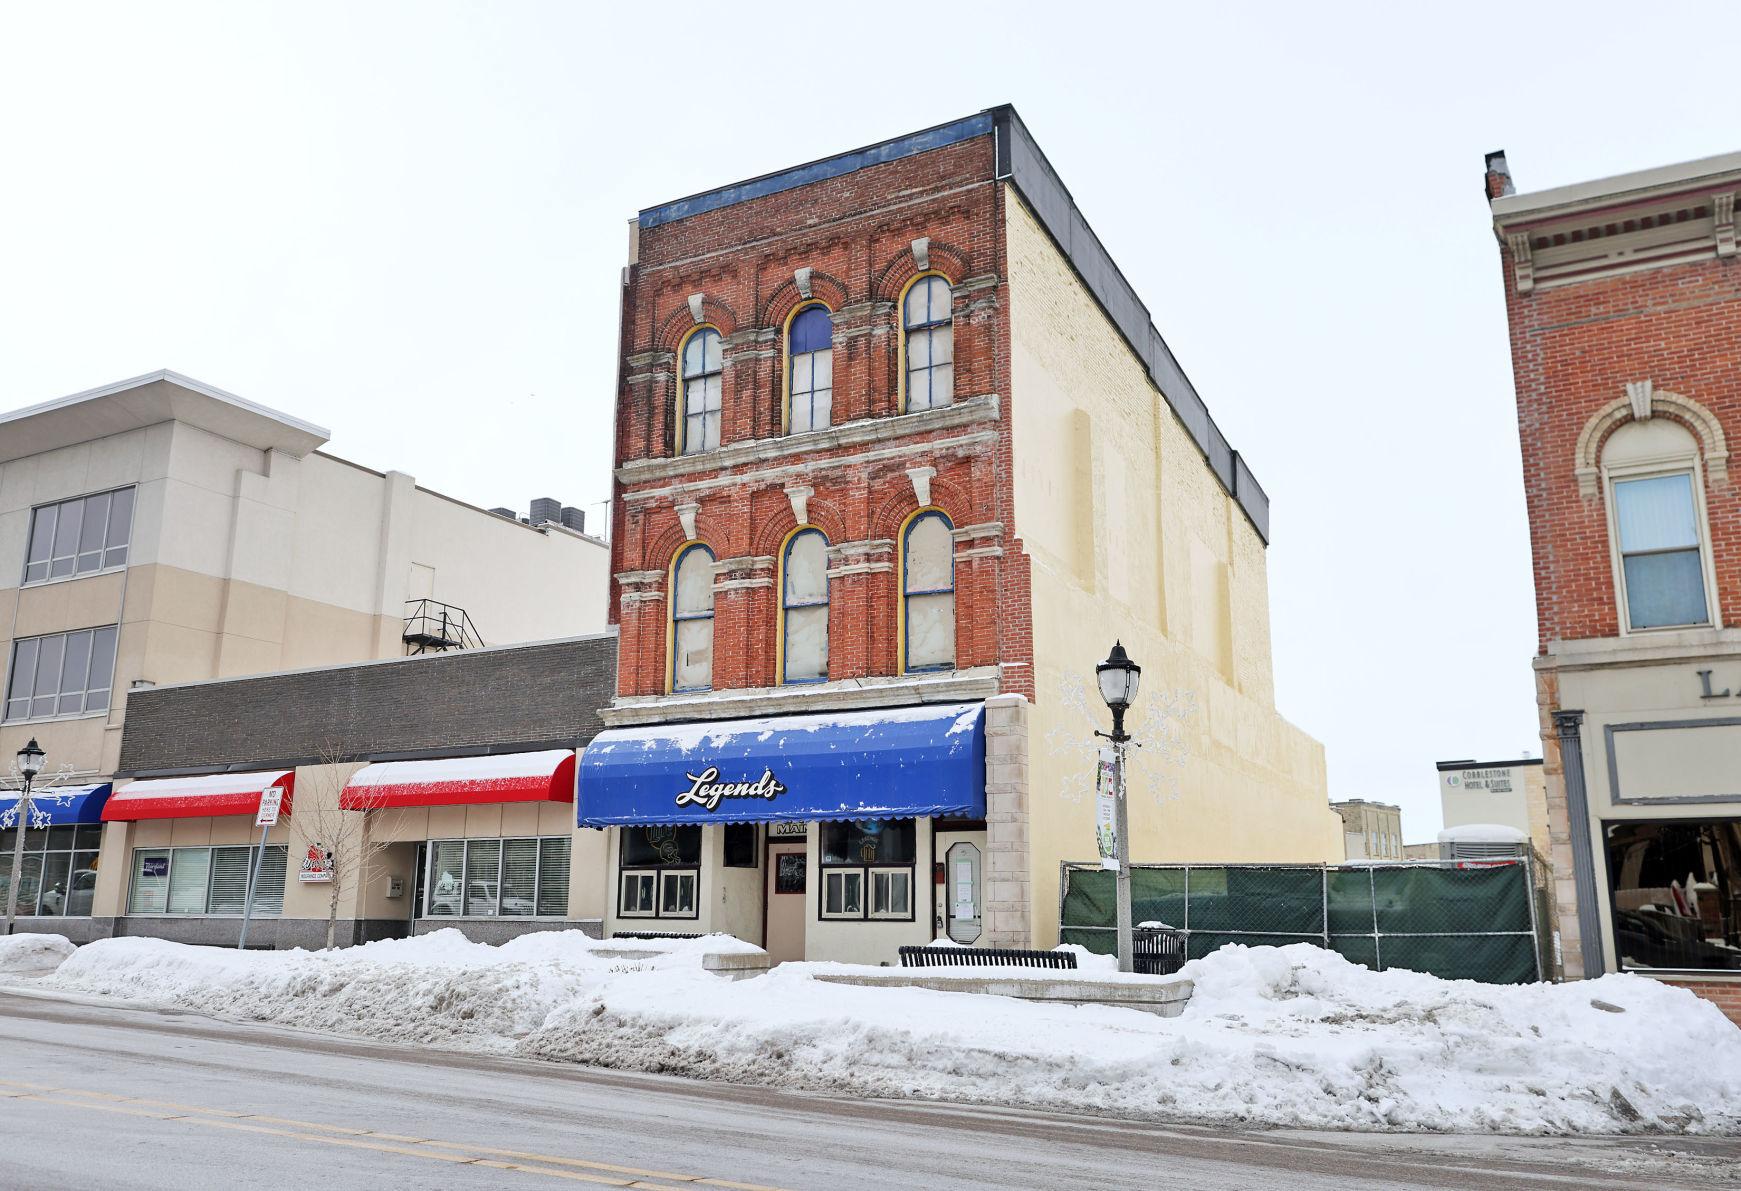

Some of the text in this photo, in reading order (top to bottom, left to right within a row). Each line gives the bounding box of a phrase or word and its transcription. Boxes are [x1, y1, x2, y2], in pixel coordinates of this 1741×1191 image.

[1462, 769, 1511, 780] COBBLESTONE
[675, 766, 787, 811] Legends
[269, 790, 277, 798] NO
[262, 798, 279, 806] PARKING
